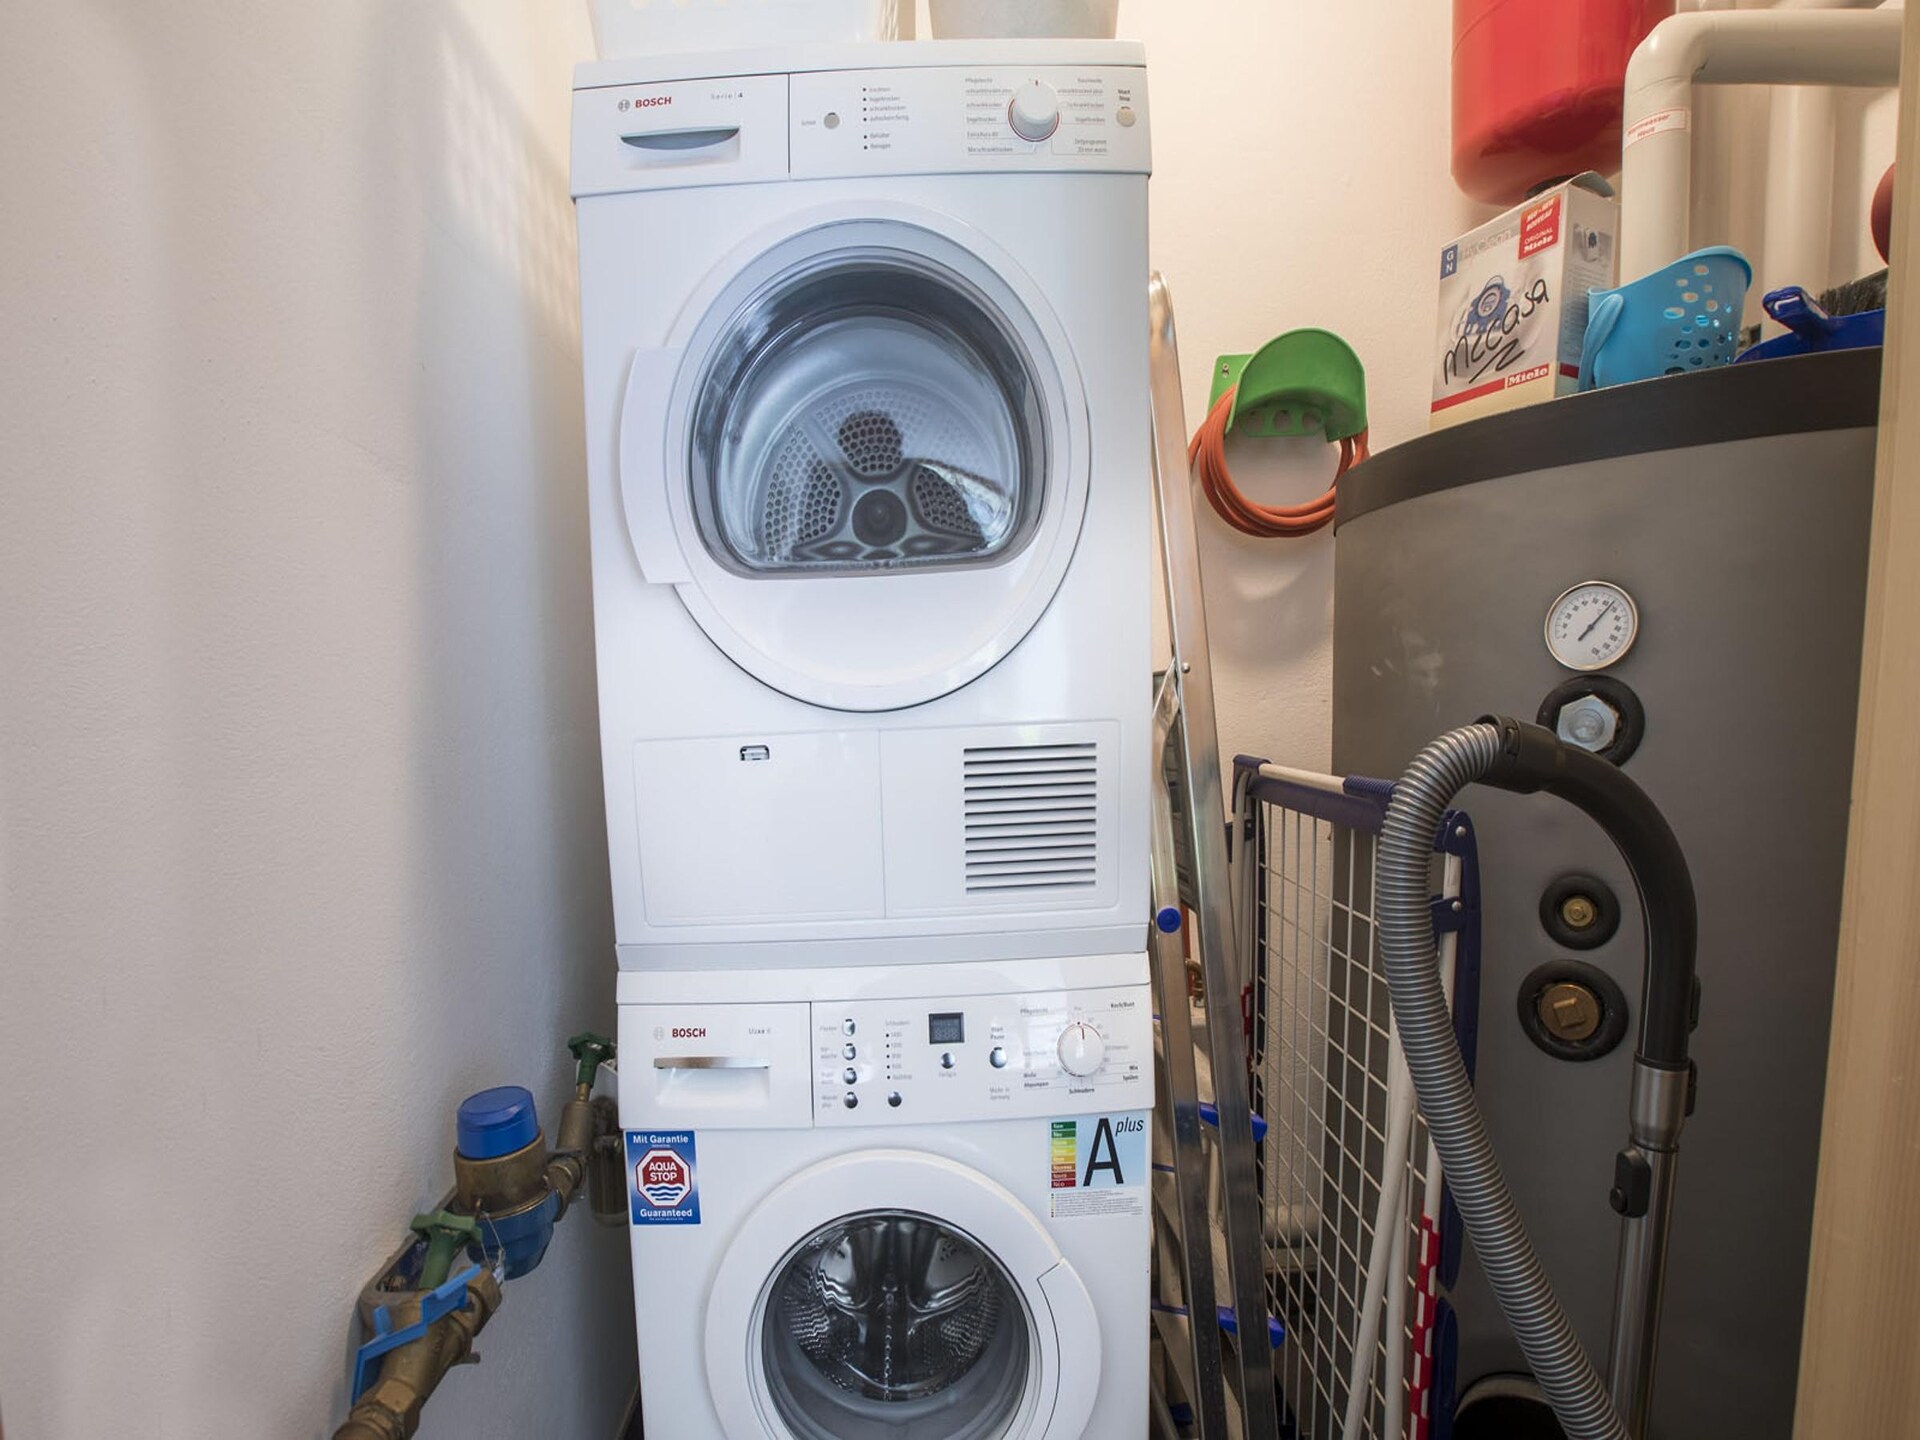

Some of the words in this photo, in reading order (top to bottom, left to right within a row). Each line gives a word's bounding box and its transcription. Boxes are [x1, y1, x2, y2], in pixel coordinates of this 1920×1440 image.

[635, 96, 672, 109] BOSCH
[1525, 227, 1553, 244] ORIGINAL
[1524, 235, 1553, 253] Miele
[1446, 250, 1454, 261] G
[1446, 262, 1452, 273] N
[1508, 367, 1548, 386] Miele
[672, 1028, 706, 1038] BOSCH
[633, 1135, 647, 1144] Mit
[650, 1134, 689, 1143] Garantie
[1083, 1117, 1124, 1187] A
[1116, 1117, 1144, 1137] plus
[649, 1162, 677, 1171] AQUA
[650, 1172, 677, 1182] STOP
[640, 1208, 692, 1217] Guaranteed
